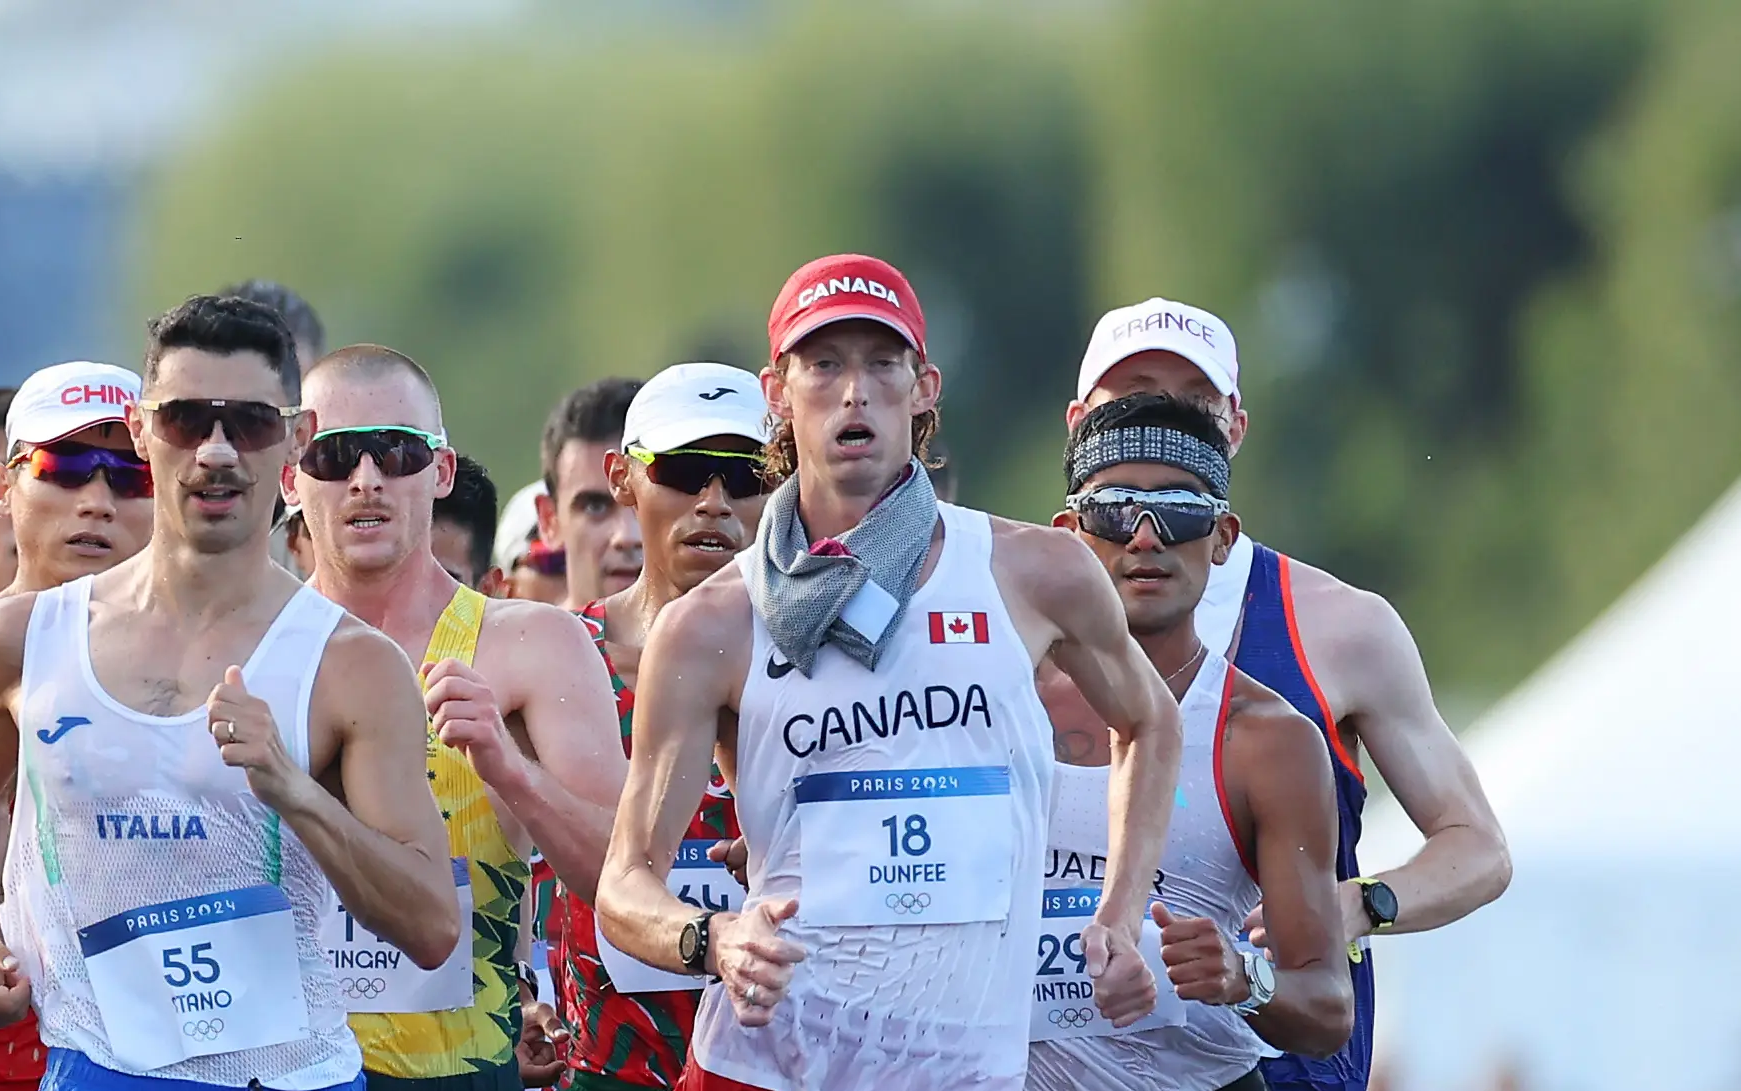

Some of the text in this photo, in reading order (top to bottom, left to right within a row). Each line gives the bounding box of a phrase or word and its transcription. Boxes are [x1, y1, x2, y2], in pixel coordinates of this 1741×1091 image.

[798, 275, 901, 309] CANADA
[1112, 312, 1216, 349] FRANCE
[782, 683, 993, 759] CANADA
[910, 776, 960, 790] 2024
[95, 813, 208, 841] ITALIA
[881, 813, 932, 858] 18
[868, 862, 947, 884] DUNFEE
[186, 900, 237, 921] 2024
[161, 941, 221, 989] 55
[1036, 932, 1087, 977] 29
[1032, 981, 1095, 1003] INTAD
